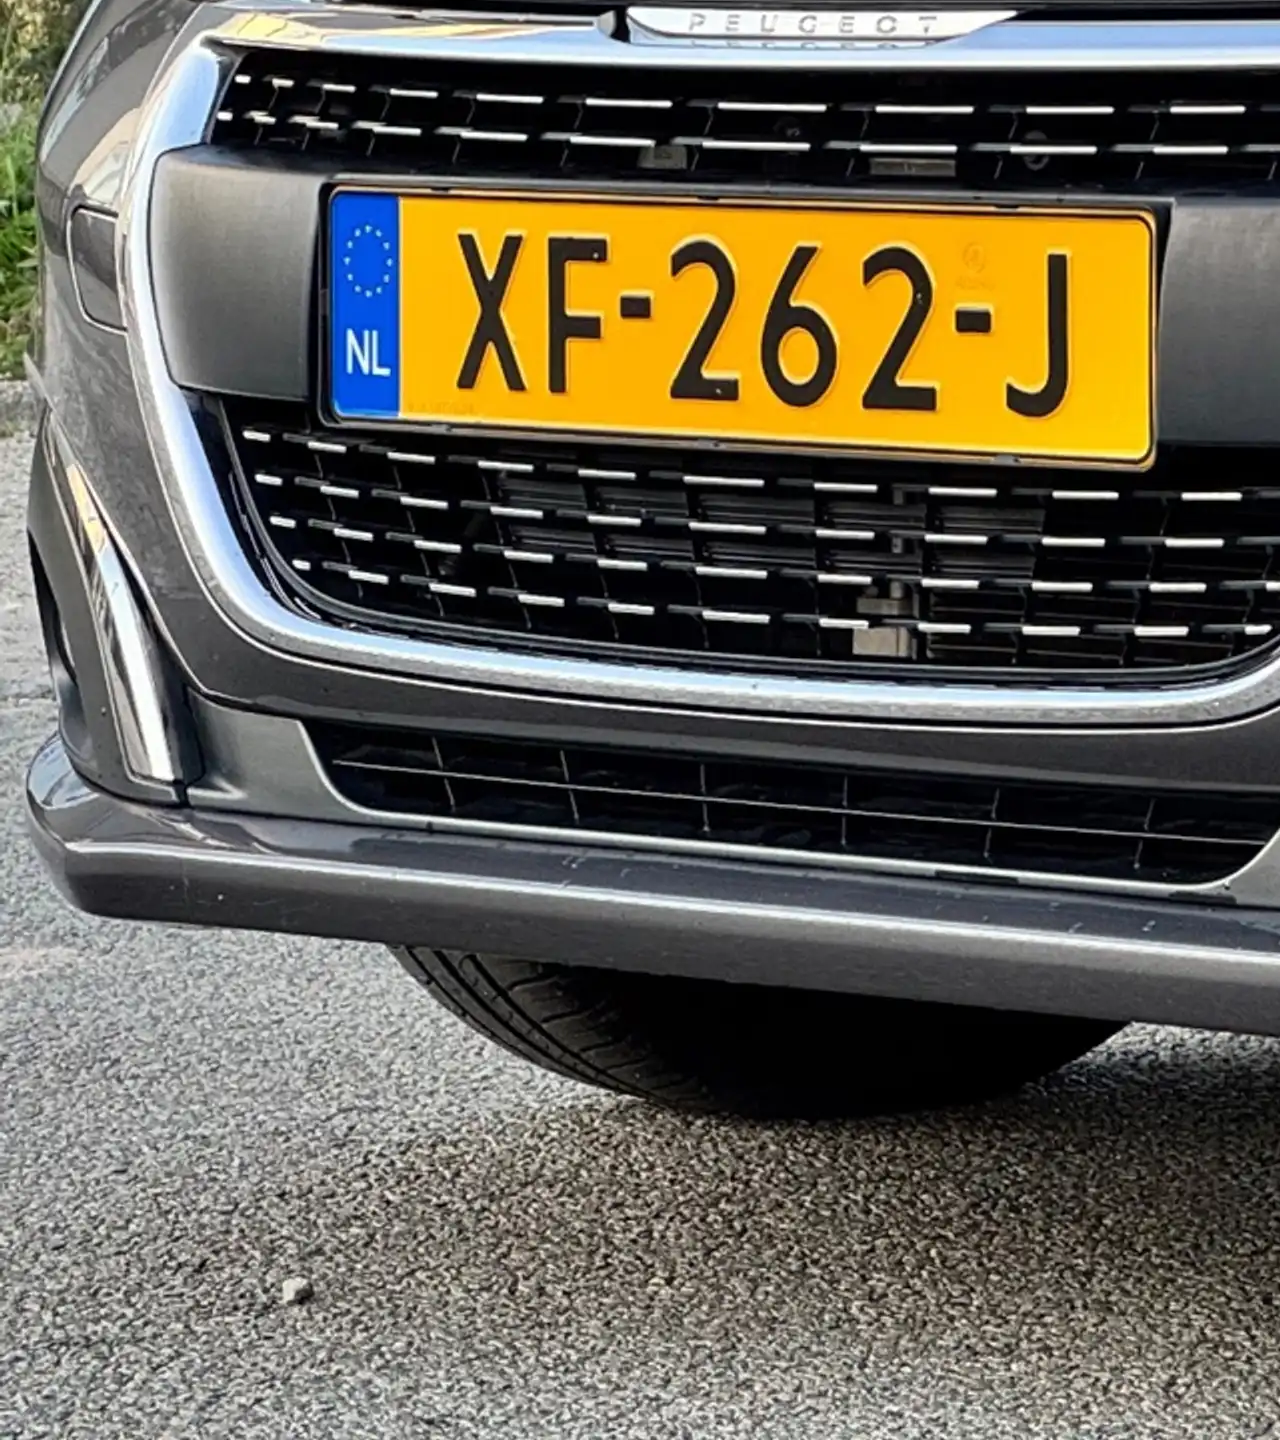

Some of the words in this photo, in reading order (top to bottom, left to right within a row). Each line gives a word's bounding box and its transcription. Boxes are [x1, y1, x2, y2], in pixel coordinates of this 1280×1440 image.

[687, 13, 938, 35] PEUGEOT
[456, 232, 1070, 419] XF-262-J
[345, 327, 392, 377] NL
